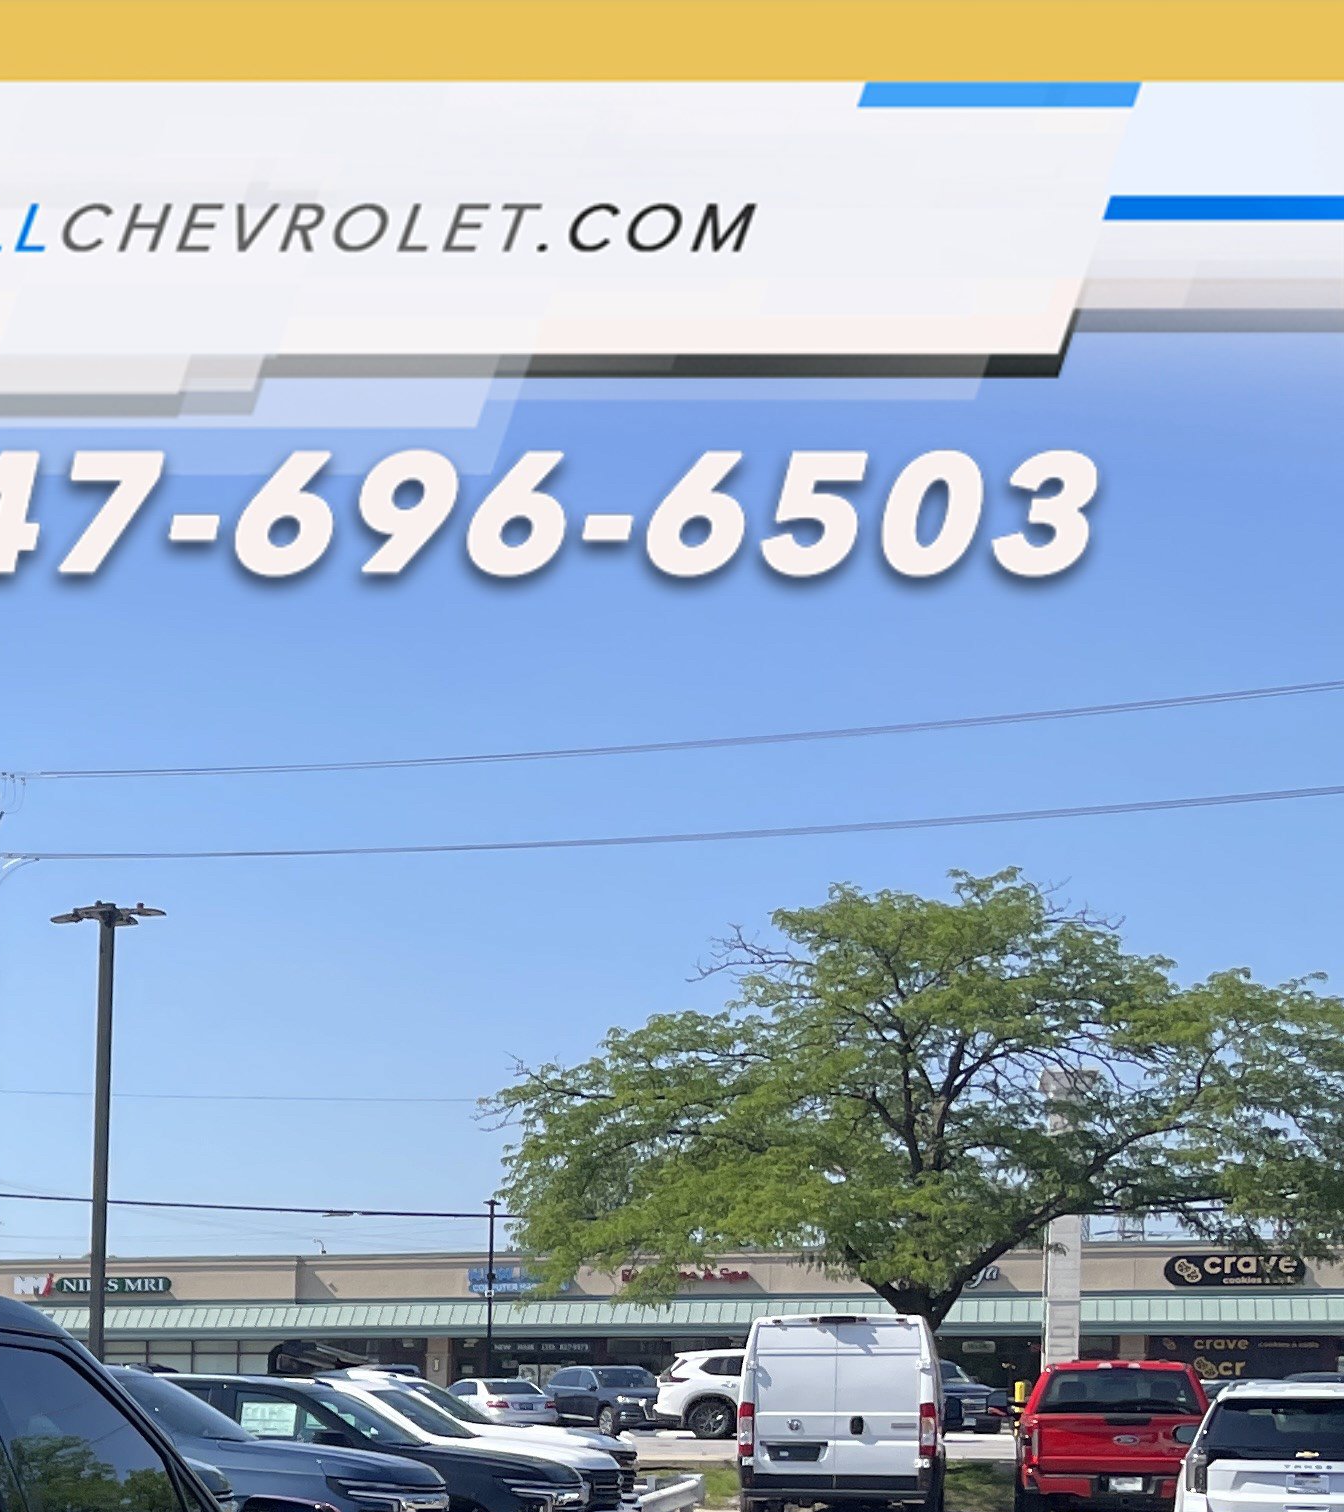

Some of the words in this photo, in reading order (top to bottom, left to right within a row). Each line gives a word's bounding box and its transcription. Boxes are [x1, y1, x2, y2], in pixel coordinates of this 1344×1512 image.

[1203, 1256, 1297, 1274] crave
[62, 1278, 119, 1292] NIS
[124, 1278, 164, 1292] MRI
[1193, 1338, 1250, 1350] crave
